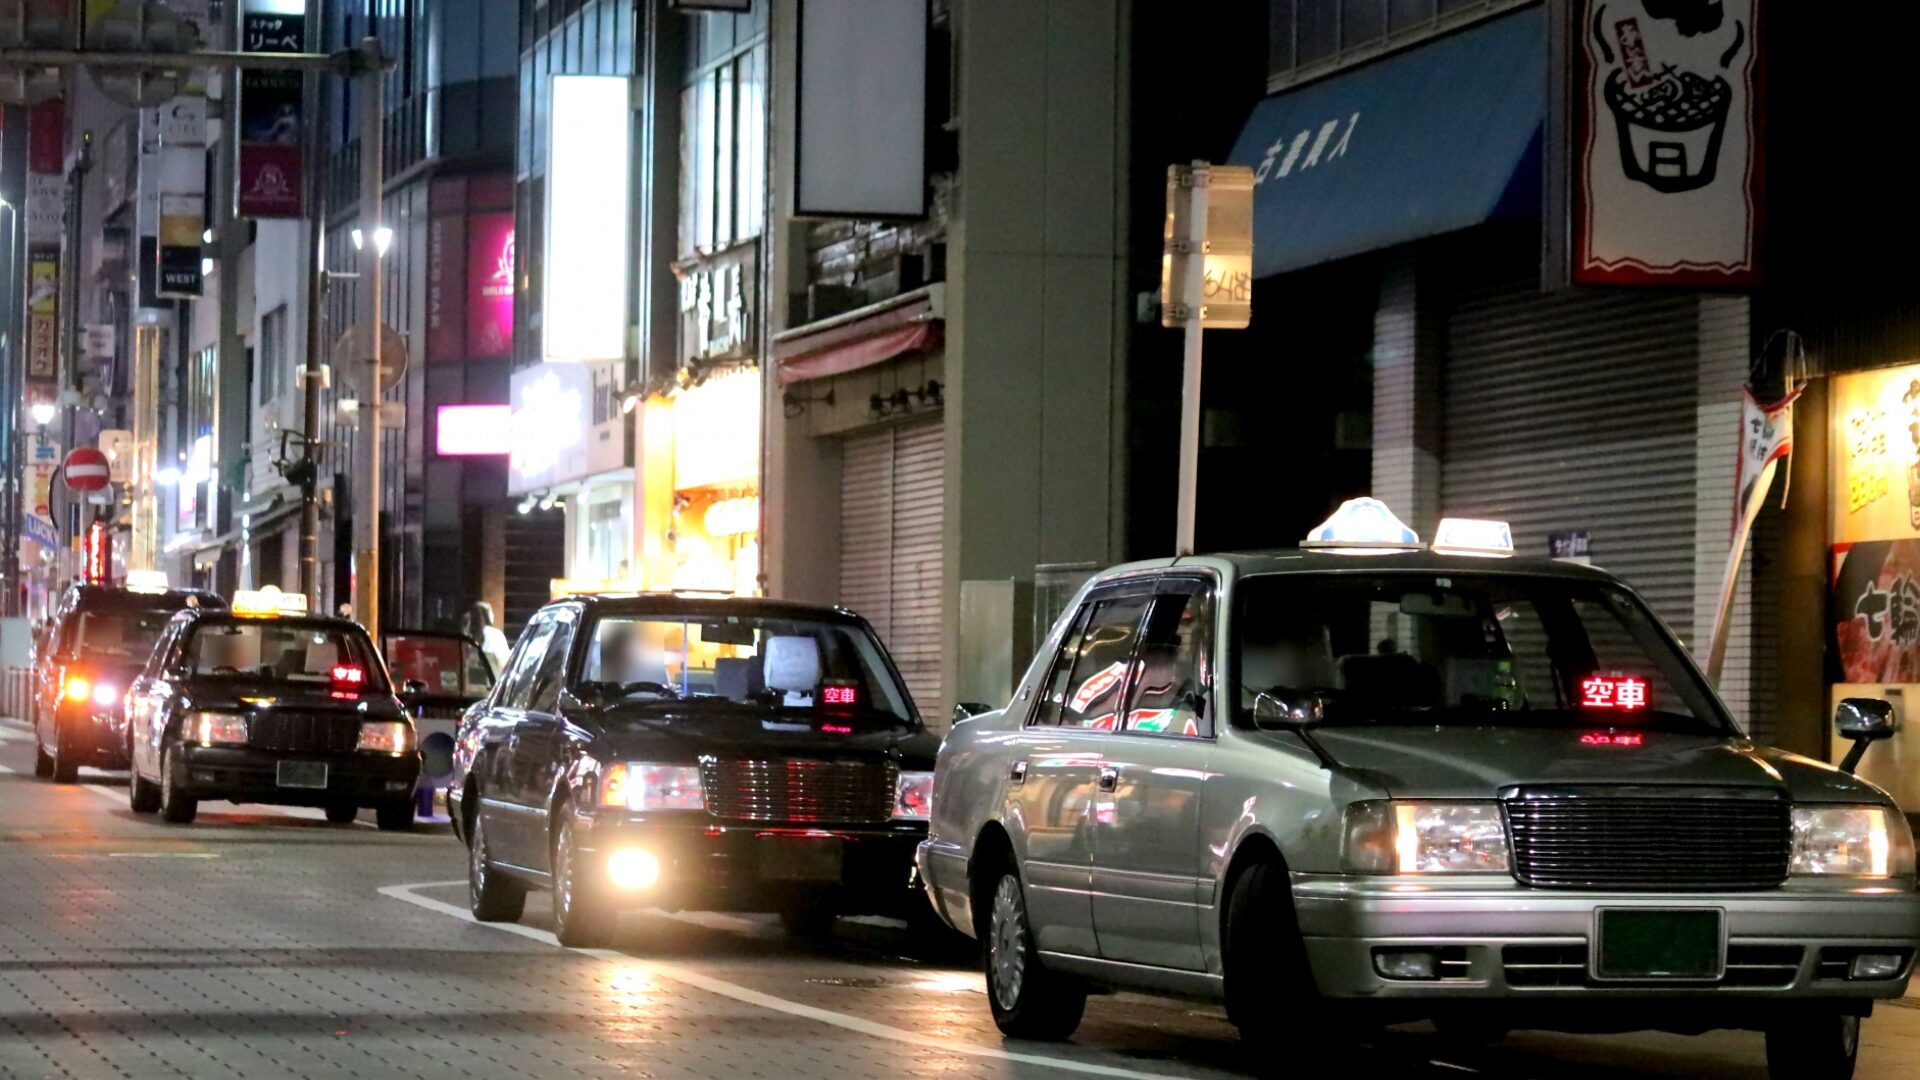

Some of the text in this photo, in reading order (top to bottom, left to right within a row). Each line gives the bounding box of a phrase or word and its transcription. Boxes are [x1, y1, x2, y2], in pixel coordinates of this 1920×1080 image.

[165, 272, 196, 284] WEST
[824, 687, 855, 704] 空車
[1582, 677, 1646, 710] 空車
